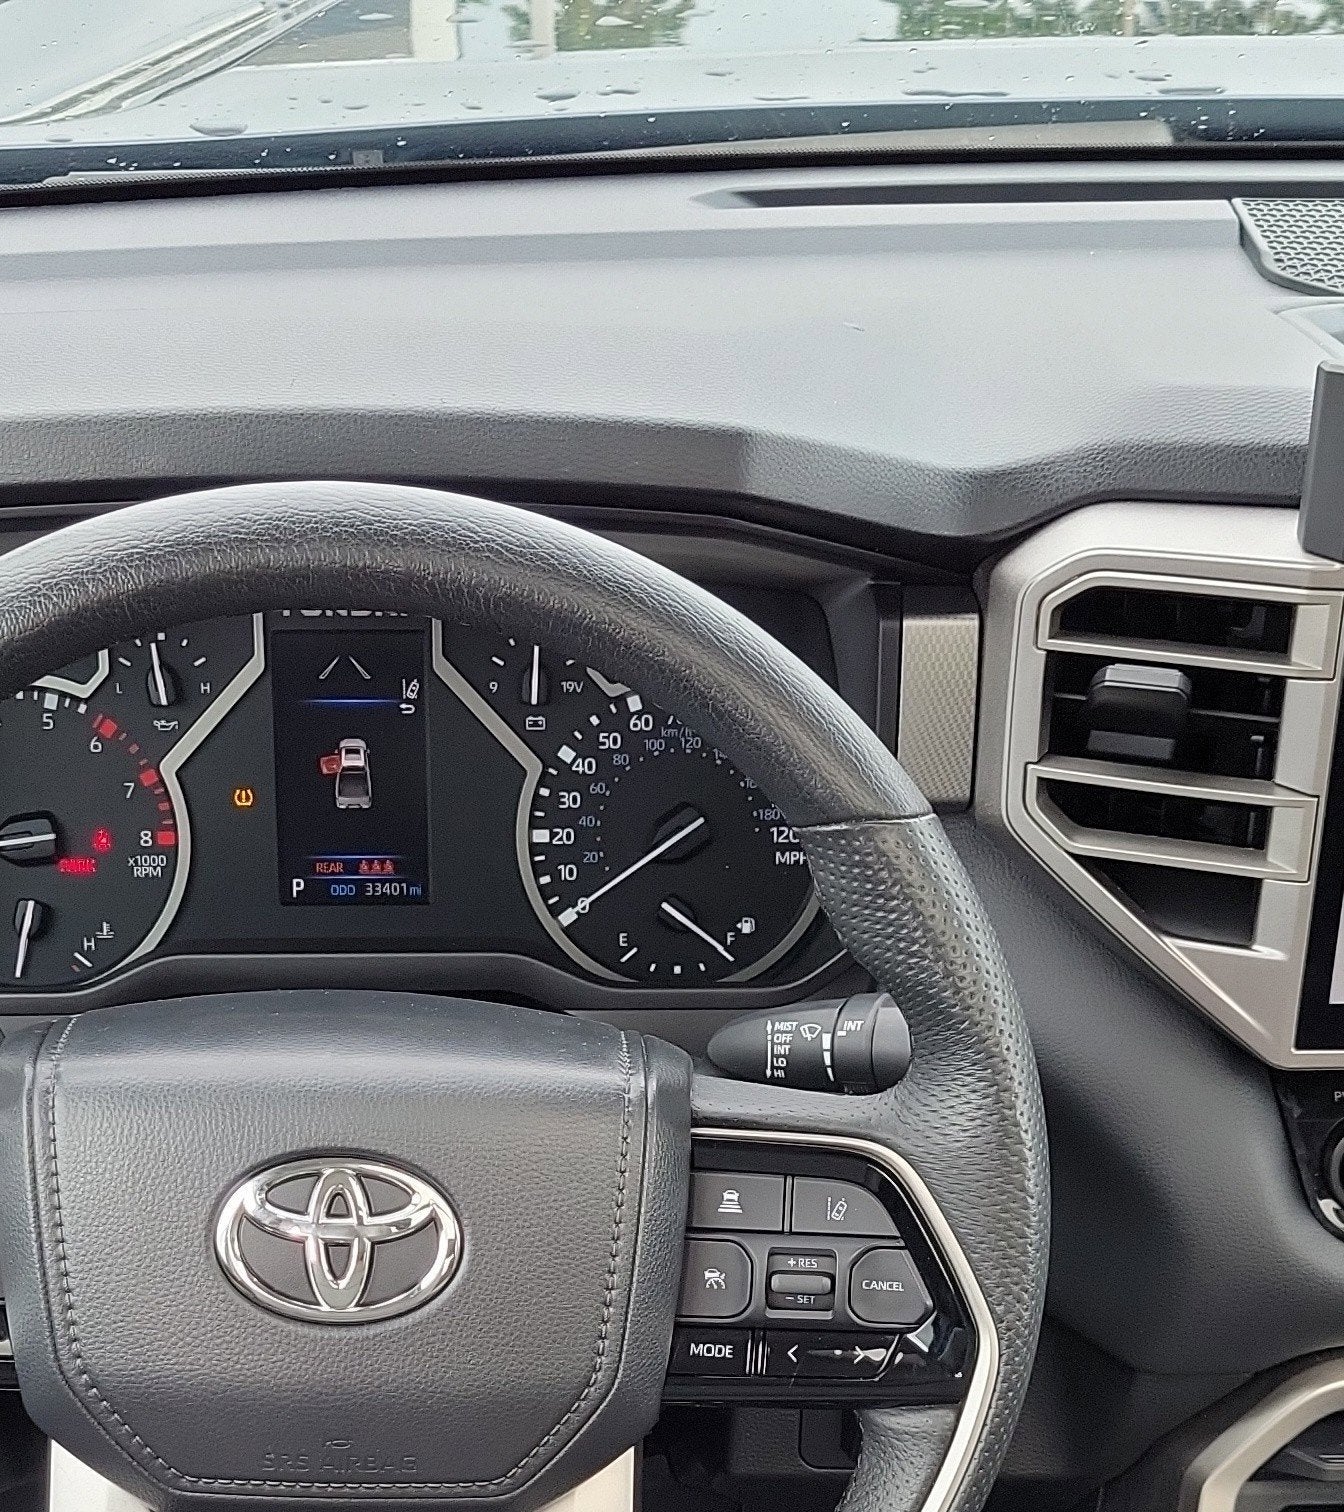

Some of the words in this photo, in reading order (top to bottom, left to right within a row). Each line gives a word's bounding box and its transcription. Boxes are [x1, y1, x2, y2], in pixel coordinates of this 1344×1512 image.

[200, 682, 210, 695] H
[488, 681, 499, 694] 9
[560, 681, 584, 694] 19V
[41, 713, 55, 730] 5
[629, 714, 654, 732] 60
[89, 737, 103, 754] 6
[598, 733, 622, 750] 50
[643, 738, 666, 751] 100
[679, 737, 703, 749] 120
[612, 752, 630, 766] 80
[572, 758, 597, 775] 40
[122, 782, 136, 798] 7
[589, 782, 607, 795] 60
[557, 792, 582, 809] 30
[578, 815, 596, 828] 40
[139, 830, 153, 847] 8
[551, 828, 576, 845] 20
[127, 854, 167, 867] x1000
[582, 851, 600, 864] 20
[133, 866, 163, 878] RPM
[315, 861, 344, 874] REAR
[557, 864, 578, 881] 10
[292, 878, 306, 898] P
[330, 884, 356, 897] ODO
[364, 882, 407, 896] 33401
[409, 884, 422, 896] mi
[83, 936, 96, 951] H
[618, 933, 629, 947] E
[726, 932, 736, 946] F
[773, 1021, 799, 1032] MIST
[842, 1020, 865, 1032] INT
[773, 1033, 794, 1044] OFF
[773, 1044, 791, 1055] INT
[773, 1057, 787, 1067] LO
[773, 1068, 786, 1079] HI
[862, 1280, 905, 1292] CANCEL
[689, 1343, 734, 1359] MODE
